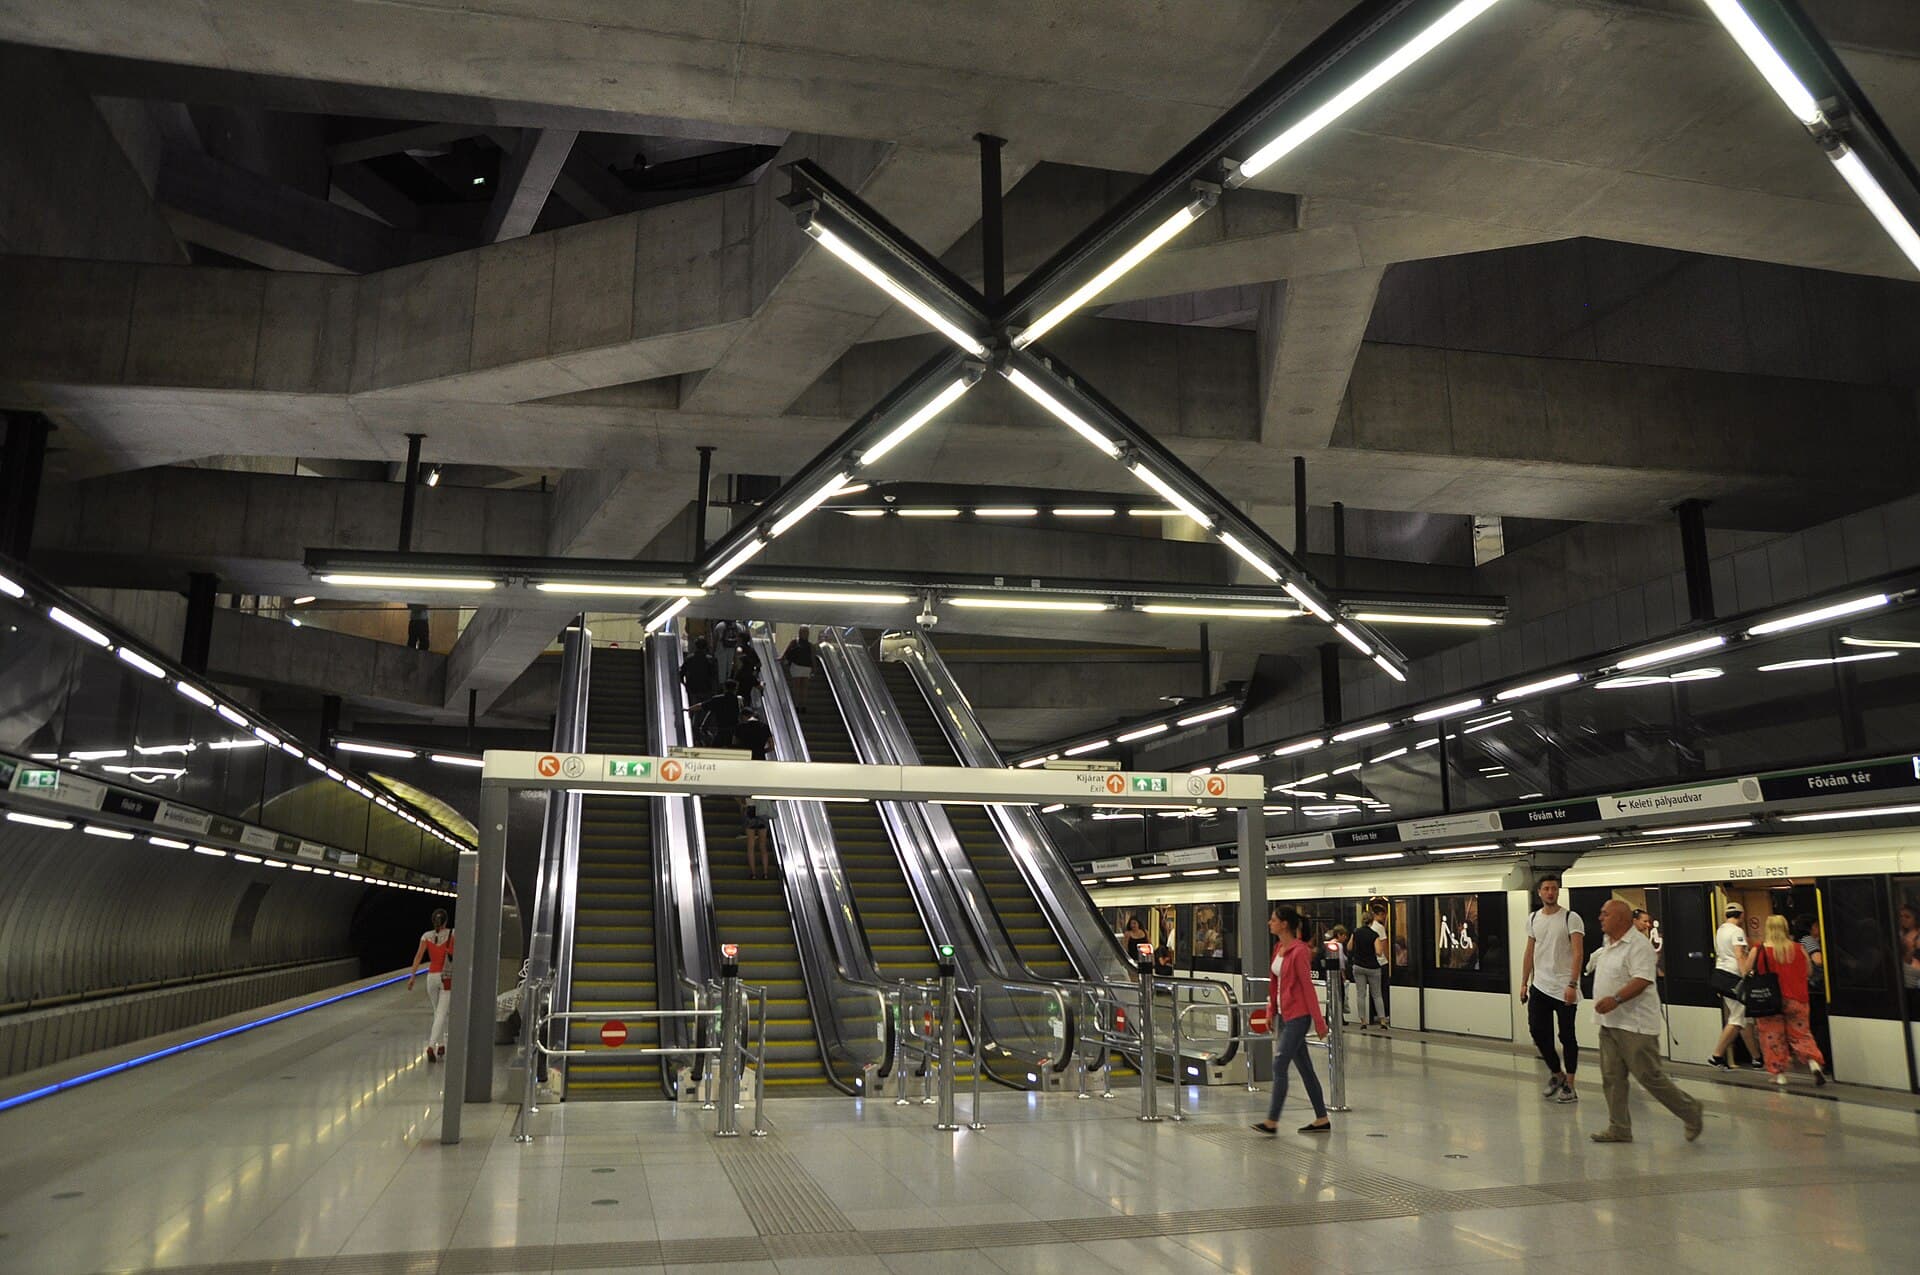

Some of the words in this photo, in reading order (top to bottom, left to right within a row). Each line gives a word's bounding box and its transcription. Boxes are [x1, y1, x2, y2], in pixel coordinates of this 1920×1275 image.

[684, 773, 701, 782] Exit
[1076, 774, 1105, 783] Kijárat
[1808, 774, 1849, 789] Fővám
[1851, 771, 1871, 784] tér
[1090, 785, 1105, 793] Exit
[1629, 797, 1653, 809] Keleti
[1655, 793, 1702, 808] pályaudvar
[1528, 810, 1553, 821] Fővám
